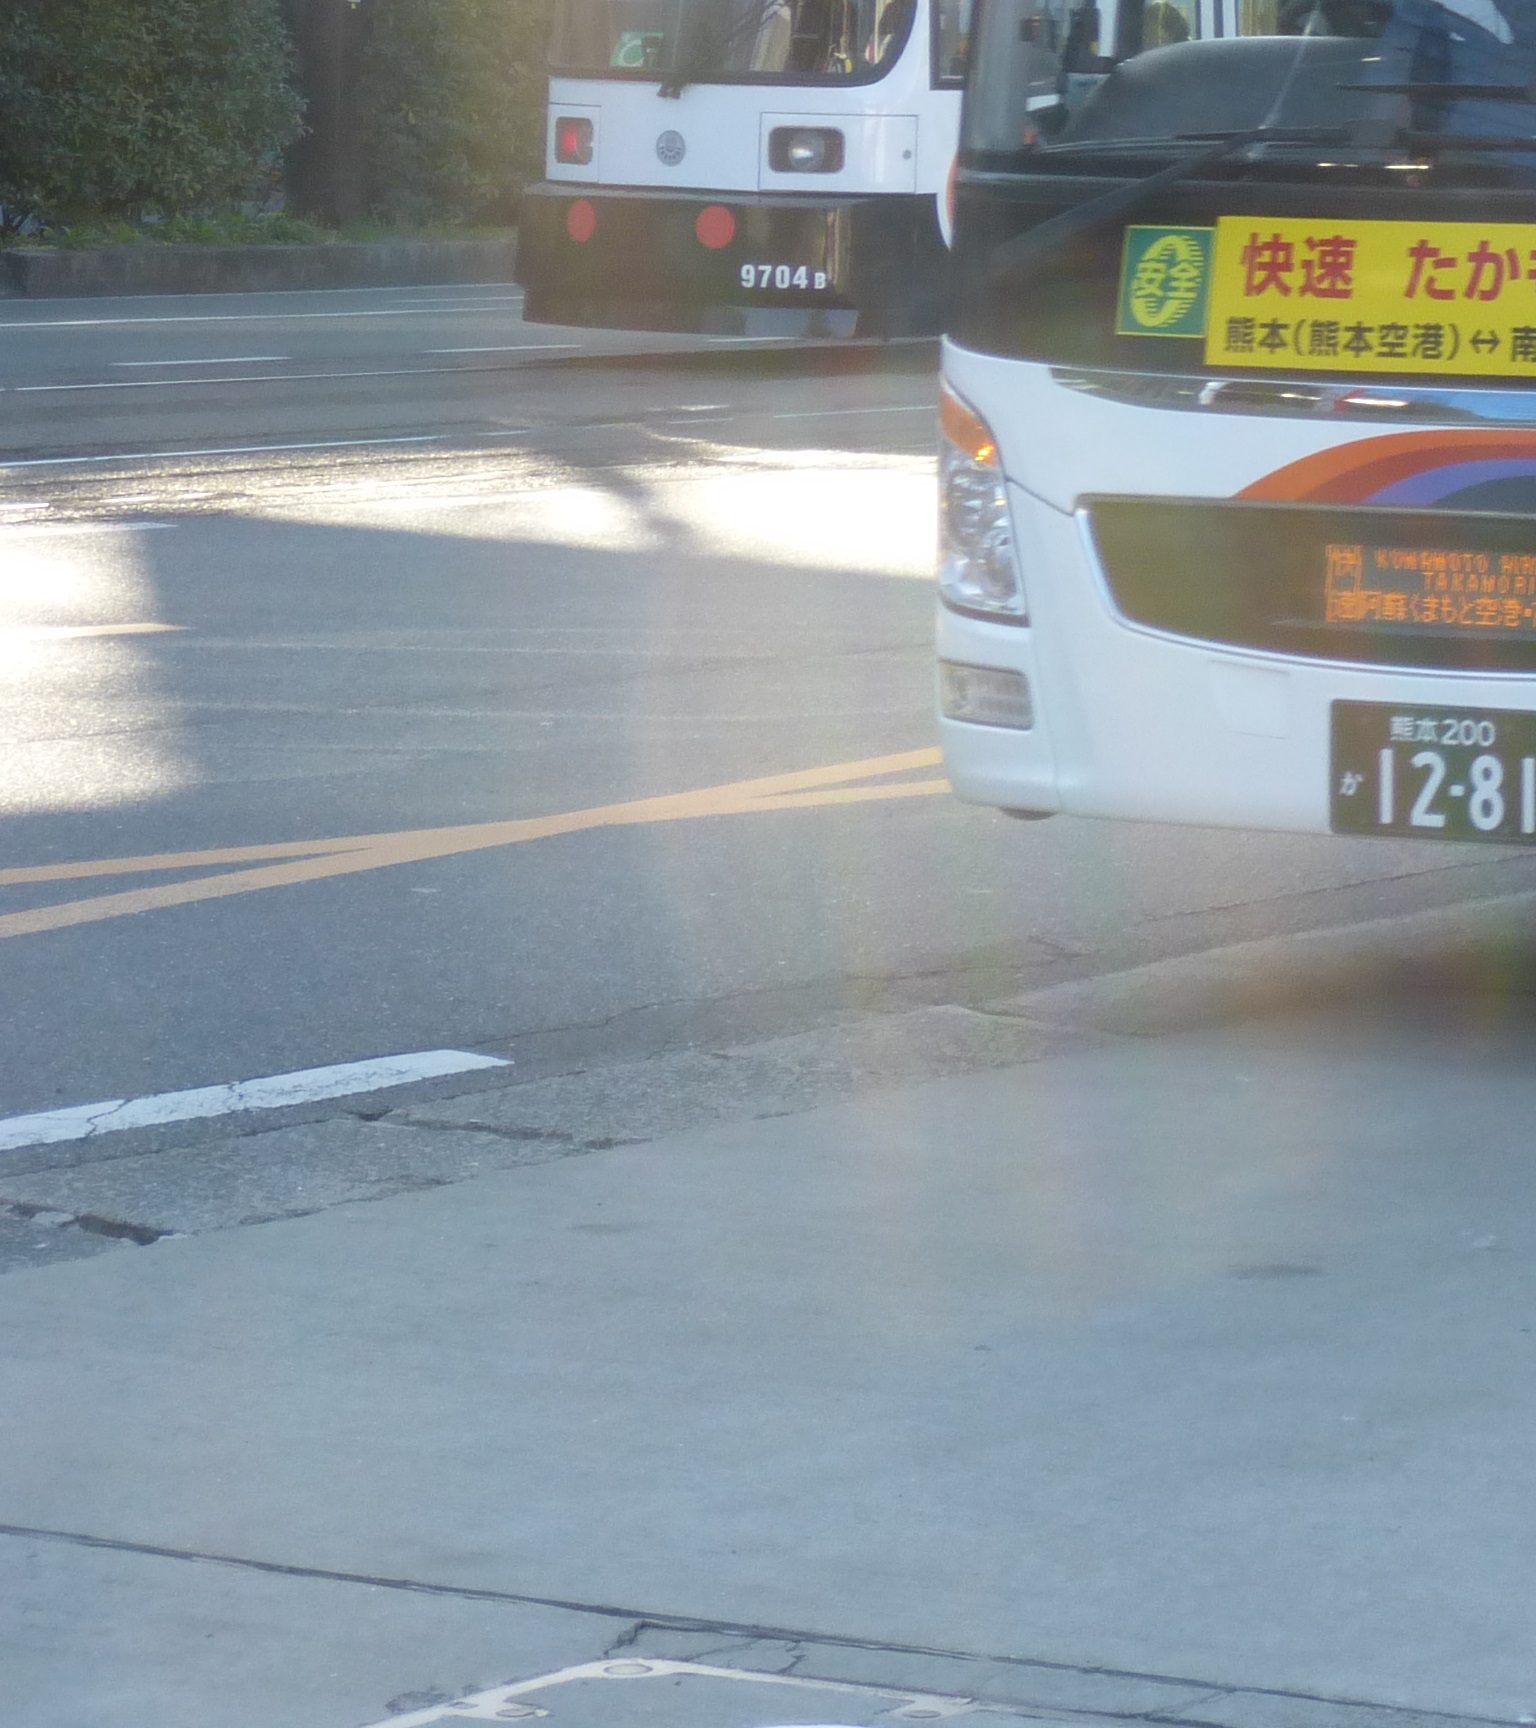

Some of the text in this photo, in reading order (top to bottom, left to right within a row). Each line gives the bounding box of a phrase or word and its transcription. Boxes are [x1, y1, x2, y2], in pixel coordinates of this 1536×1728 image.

[740, 263, 827, 290] 9704 B
[1241, 230, 1358, 301] 快速
[1224, 317, 1460, 362] 熊本(熊本空港)
[1389, 716, 1496, 747] 熊本200
[1339, 746, 1536, 834] か 12-81
